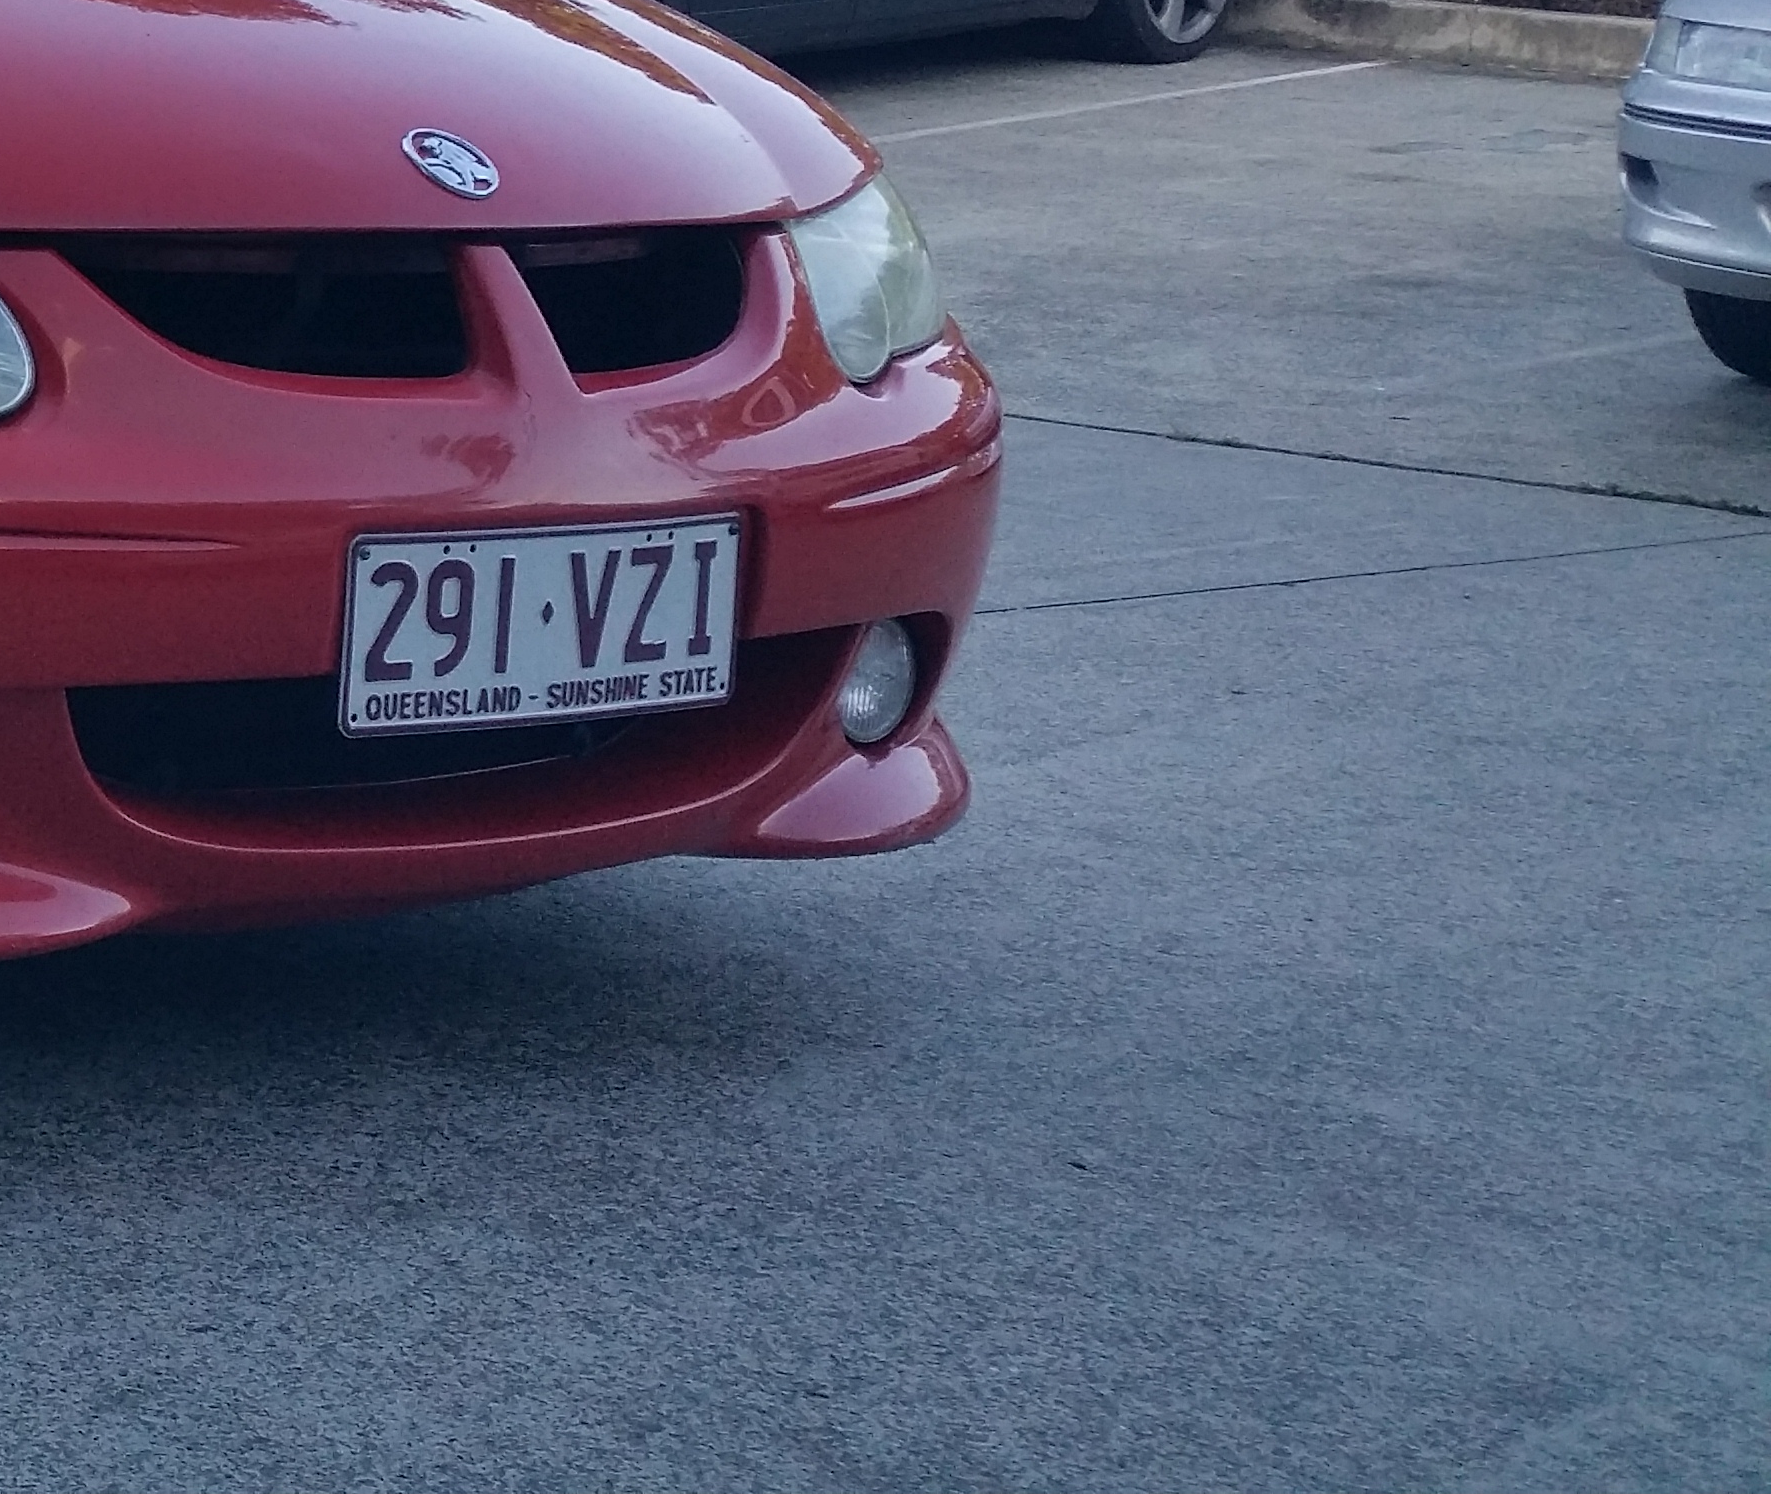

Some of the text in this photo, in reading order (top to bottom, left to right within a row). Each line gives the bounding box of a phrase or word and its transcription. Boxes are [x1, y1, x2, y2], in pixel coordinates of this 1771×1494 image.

[365, 686, 521, 721] QUEENSLAND
[546, 674, 649, 708] SUNSHINE
[659, 666, 718, 696] STATE
